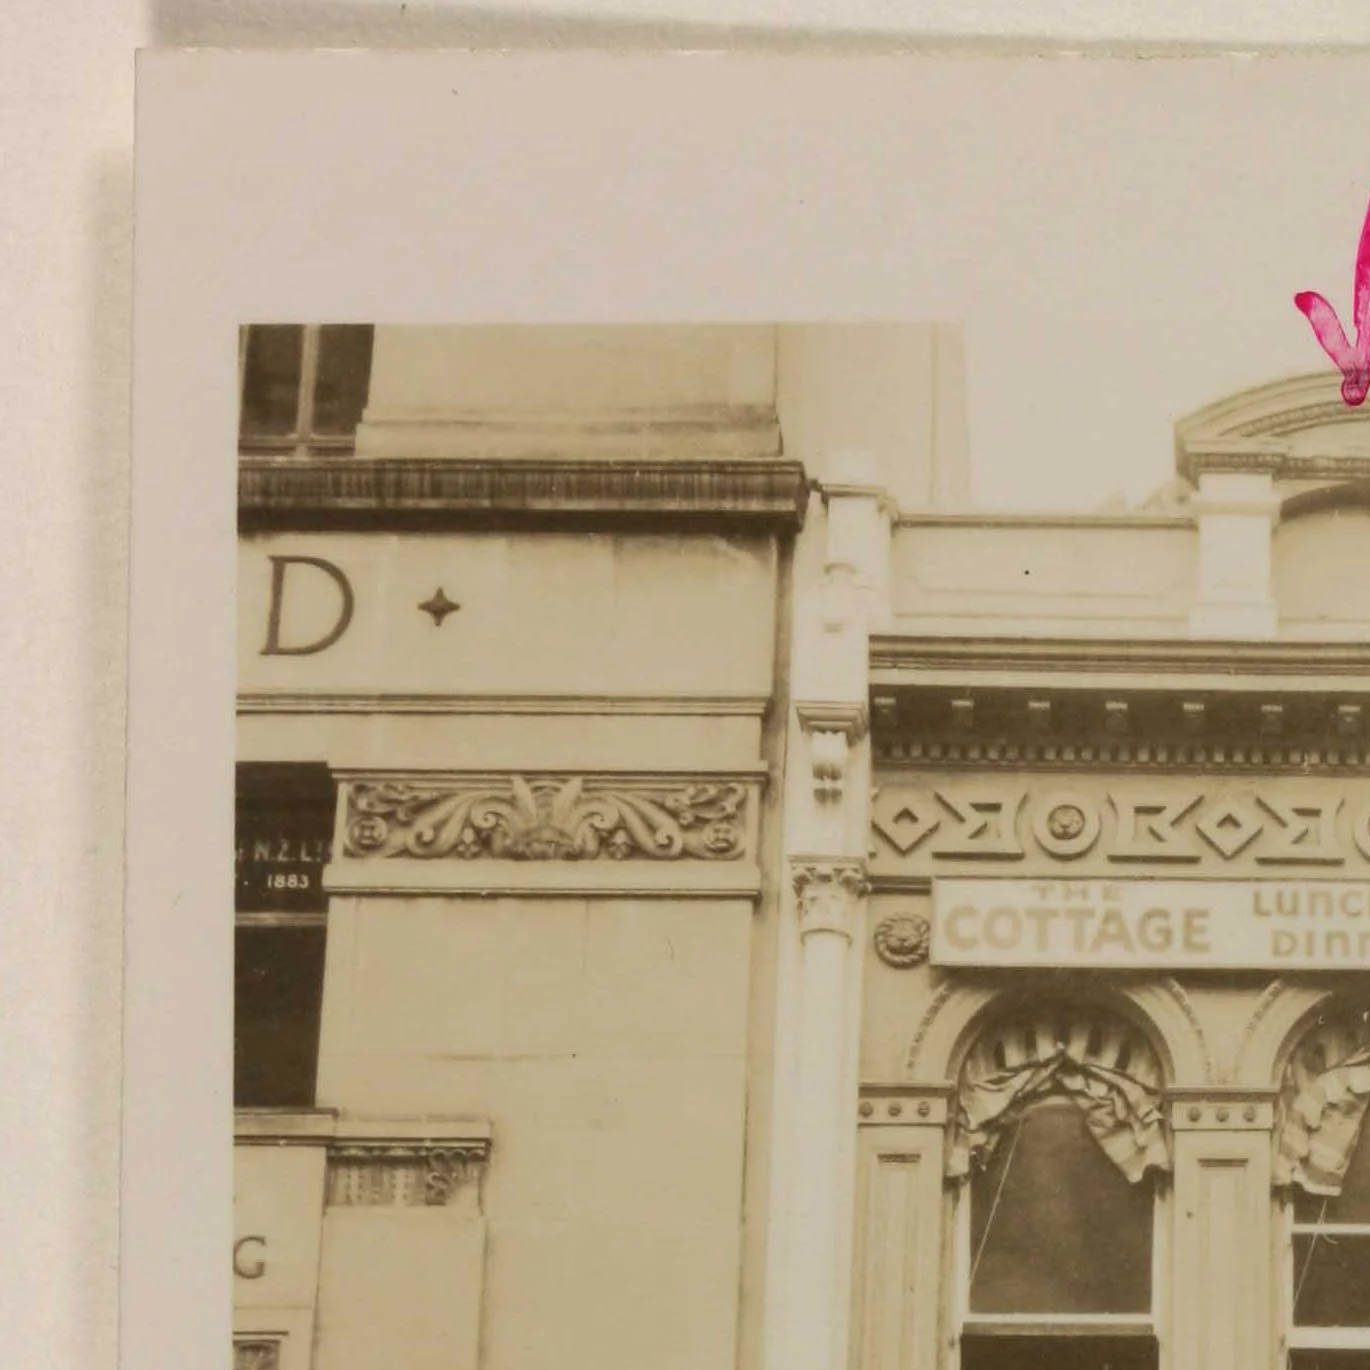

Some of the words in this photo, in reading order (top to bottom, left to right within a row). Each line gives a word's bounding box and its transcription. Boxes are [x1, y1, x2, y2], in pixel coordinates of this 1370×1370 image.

[267, 873, 309, 889] 1883
[1033, 882, 1125, 902] THE
[943, 906, 1213, 954] COTTAGE
